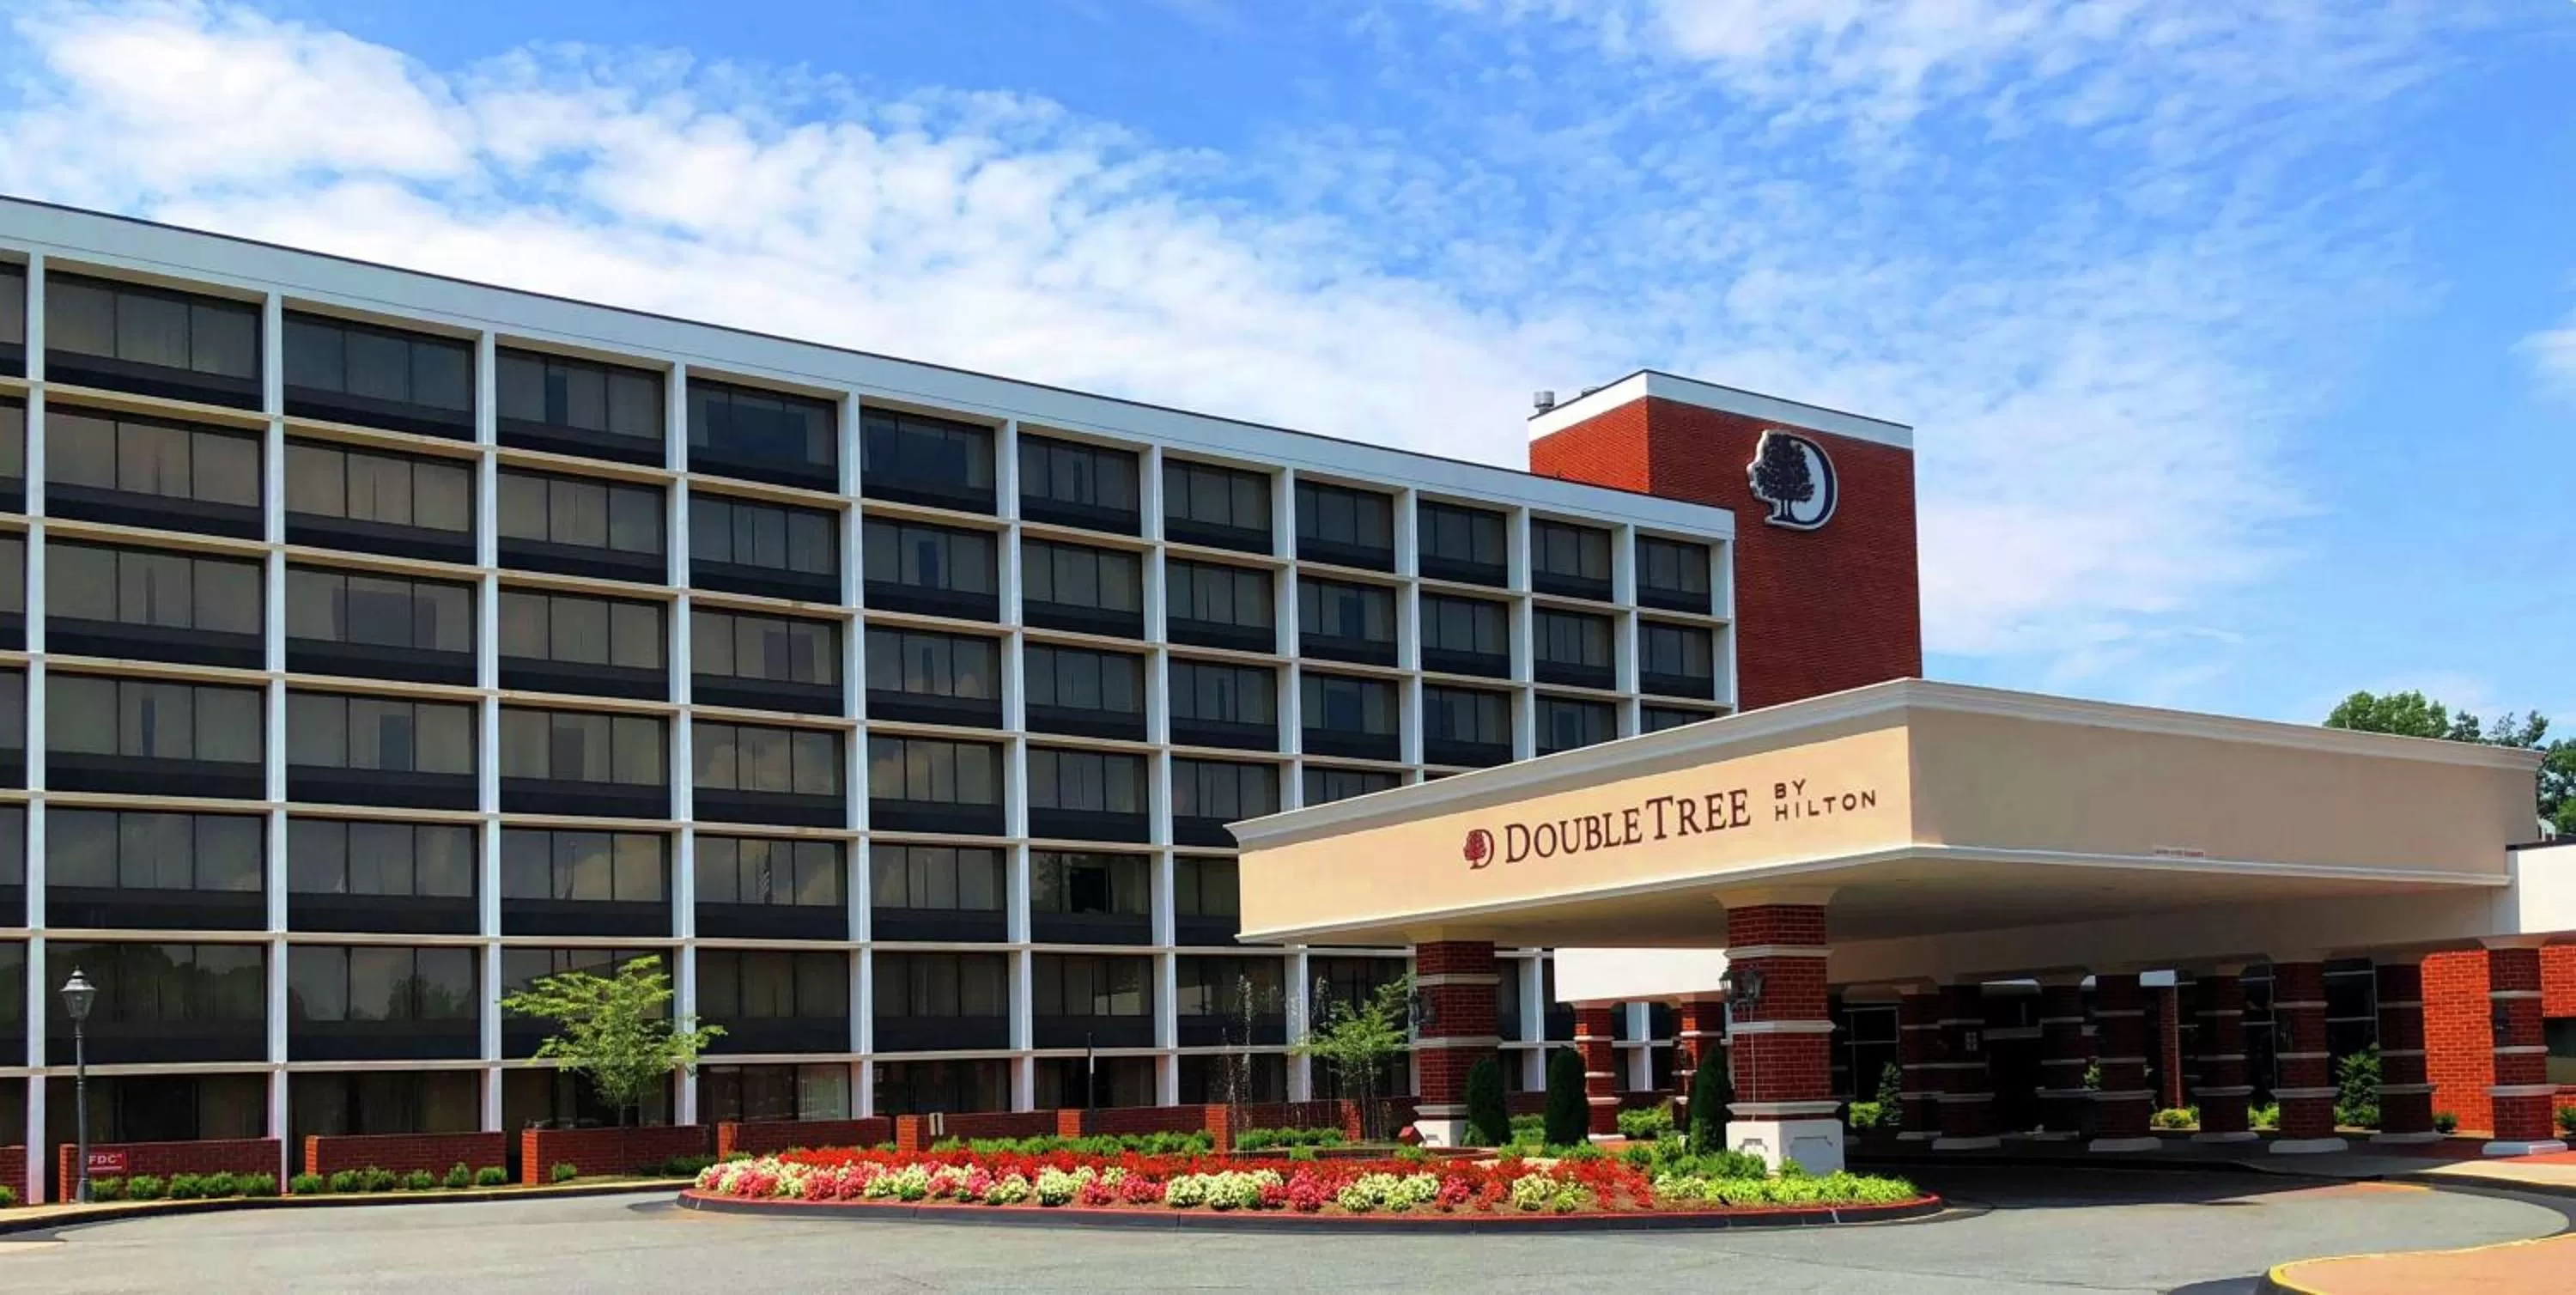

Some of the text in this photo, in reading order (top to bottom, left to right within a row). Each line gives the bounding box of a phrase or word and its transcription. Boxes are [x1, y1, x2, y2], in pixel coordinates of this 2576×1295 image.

[1774, 778, 1807, 799] BY
[1774, 789, 1876, 822] HILTON
[1504, 788, 1751, 864] DOUBLETREE
